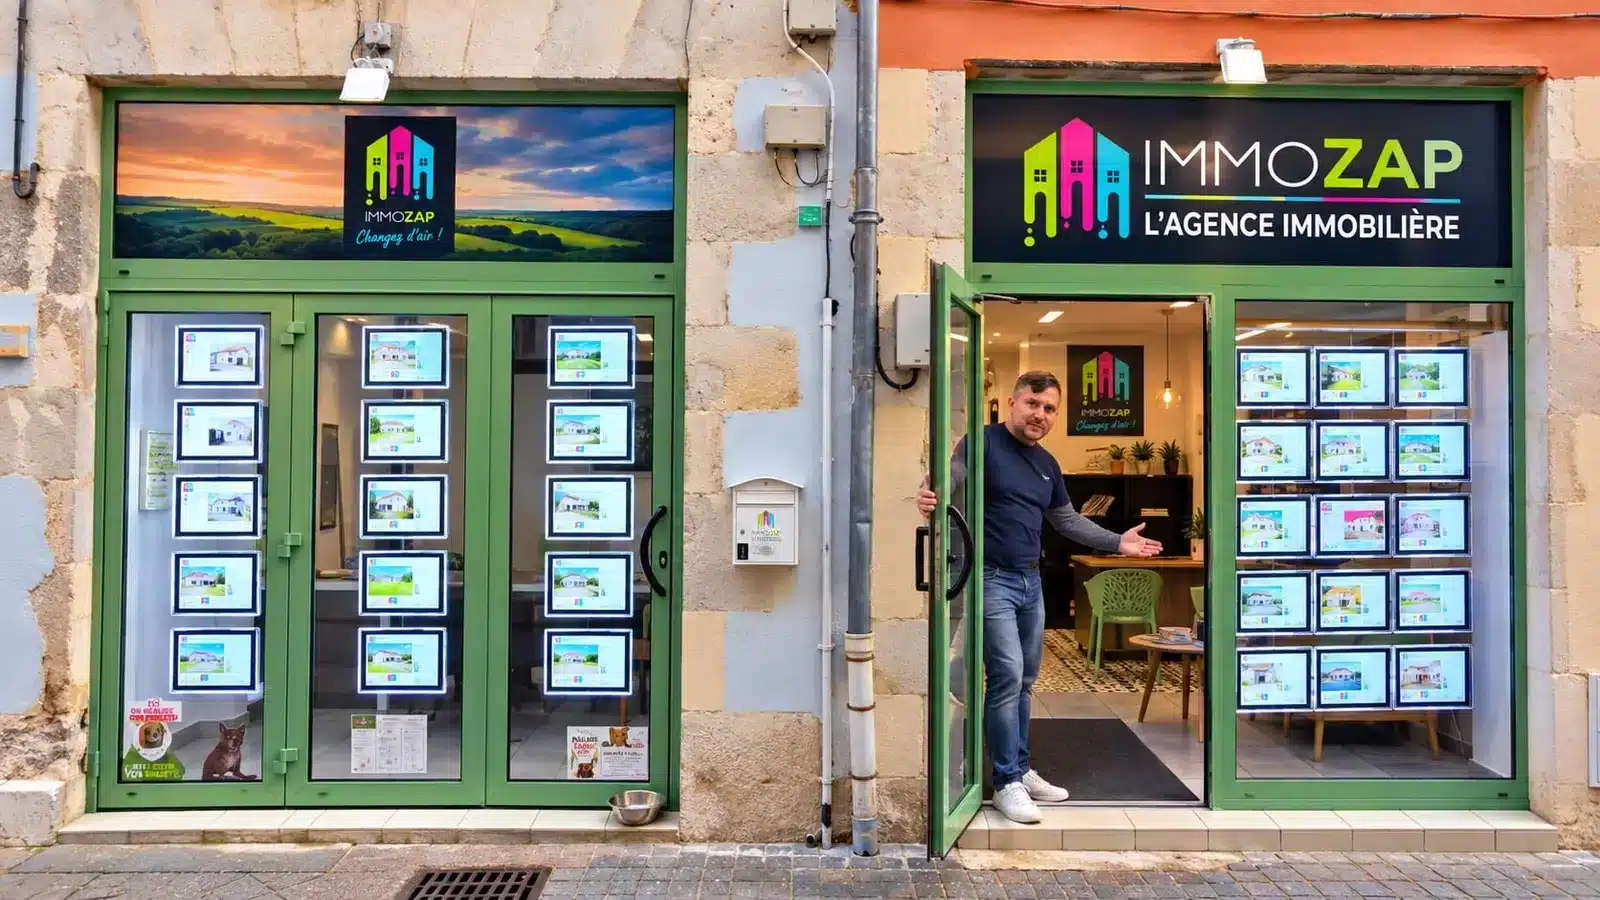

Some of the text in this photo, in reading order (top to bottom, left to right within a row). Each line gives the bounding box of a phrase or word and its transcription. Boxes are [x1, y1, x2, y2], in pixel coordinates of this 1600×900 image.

[1144, 138, 1463, 189] IMMOZAP
[364, 211, 435, 223] IMMOZAP
[1283, 208, 1461, 239] IMMOBILIÈRE
[356, 229, 403, 249] Changez
[407, 227, 434, 242] d'air
[1081, 408, 1131, 417] IMMOZAP
